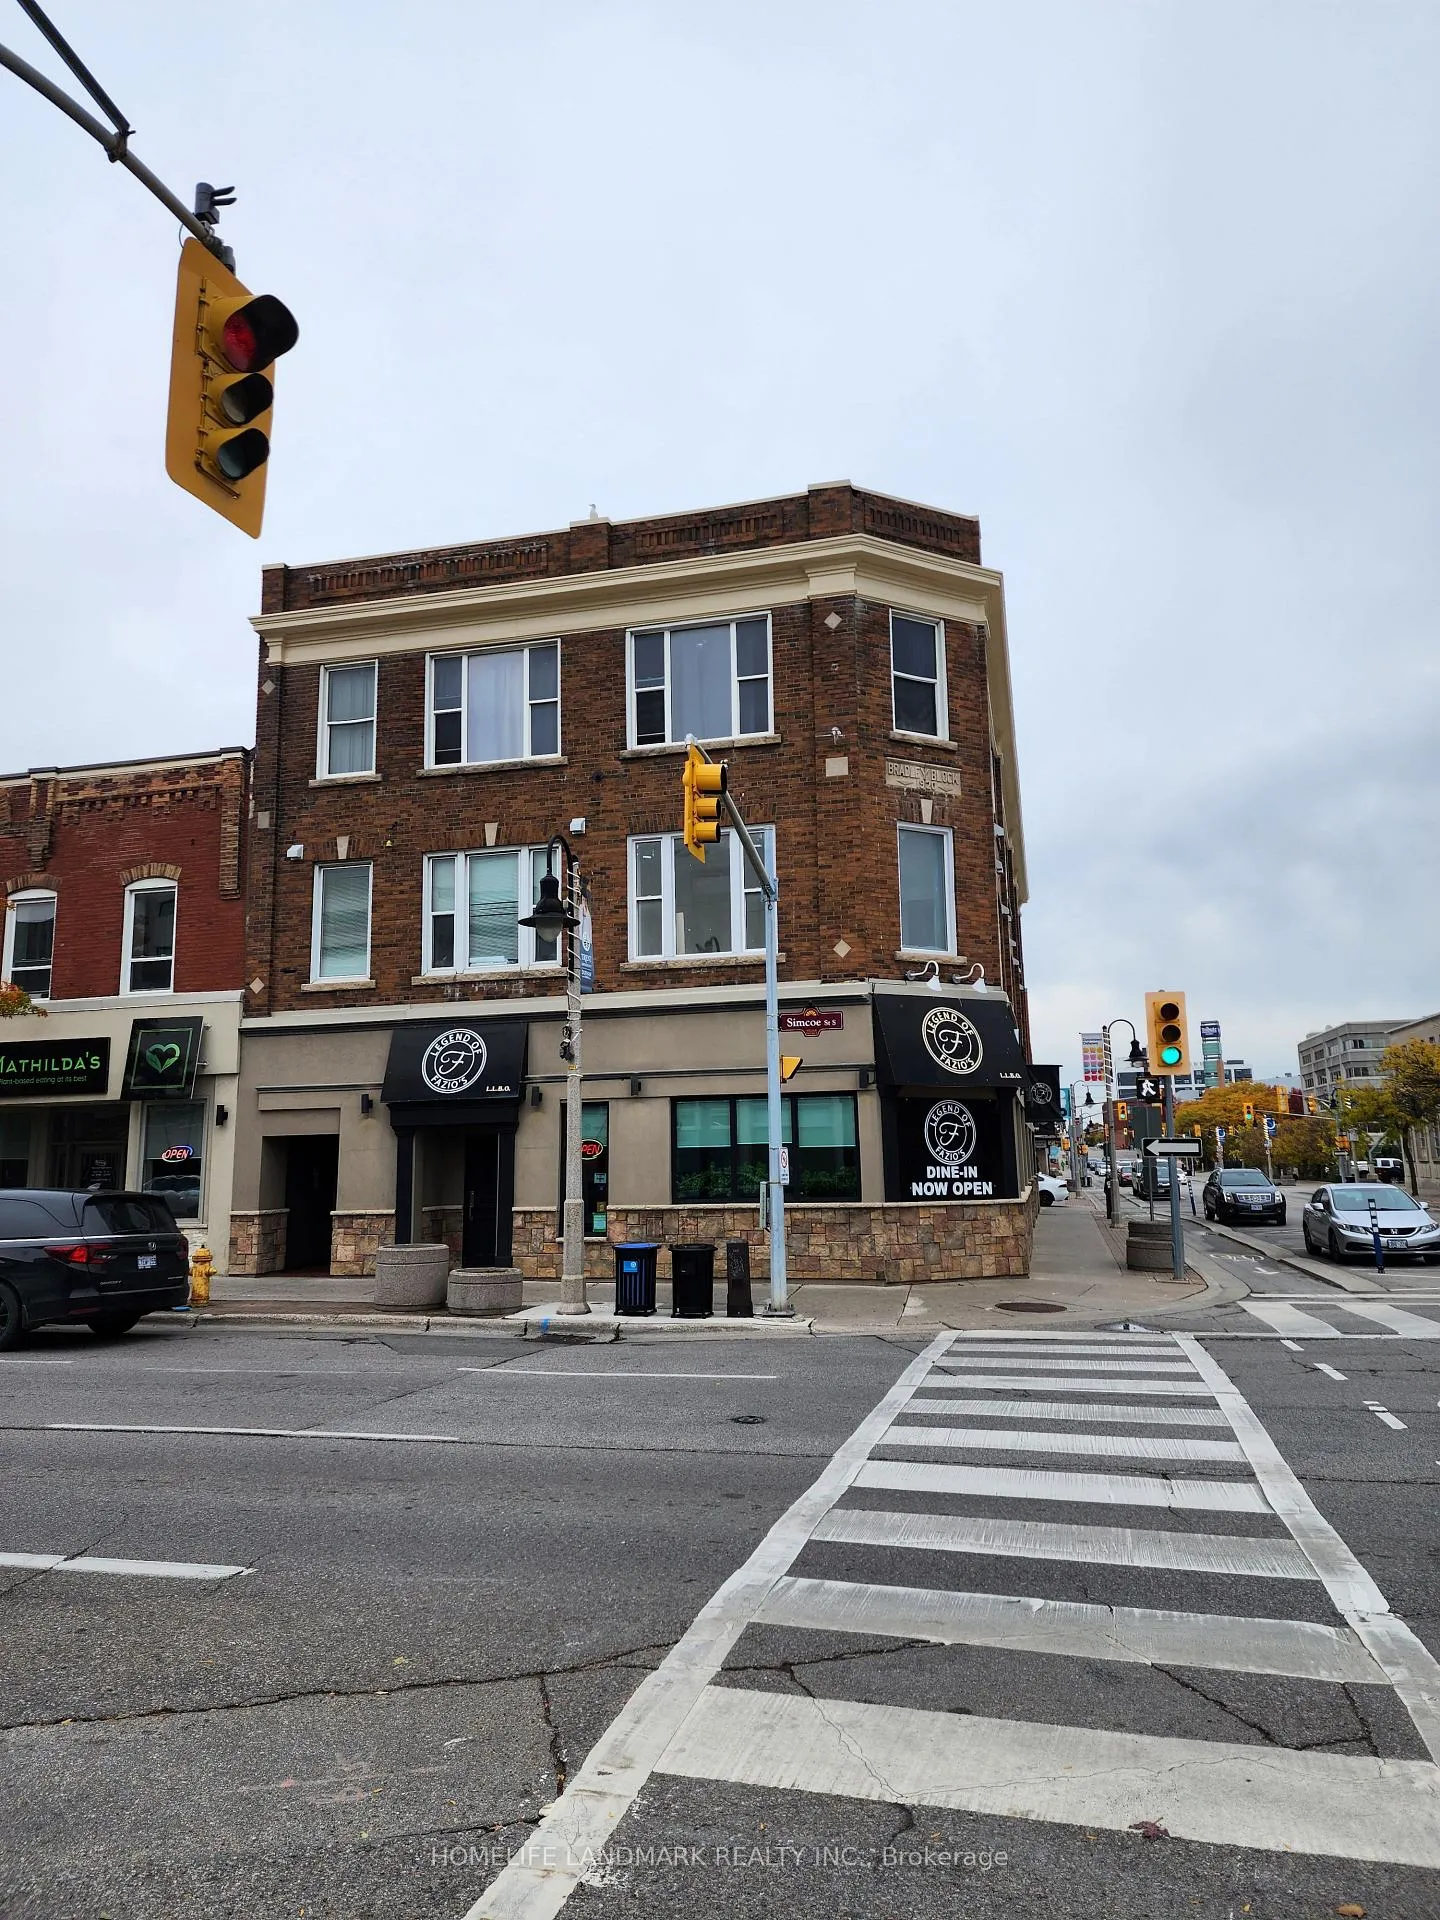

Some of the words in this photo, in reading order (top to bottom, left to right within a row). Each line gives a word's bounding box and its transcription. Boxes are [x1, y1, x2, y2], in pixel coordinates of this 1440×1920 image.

[889, 763, 929, 781] BRADLEY
[932, 769, 959, 785] BLOCK
[916, 780, 936, 790] 1920
[786, 1017, 821, 1027] Simcoe
[927, 1012, 957, 1034] LEGEND
[961, 1021, 974, 1036] OF
[430, 1033, 470, 1056] LEGEND
[471, 1041, 482, 1055] OF
[940, 1054, 975, 1070] FAZIO'S
[430, 1074, 468, 1089] FAZIO'S
[929, 1104, 960, 1127] LEGEND
[961, 1114, 972, 1128] OF
[164, 1148, 189, 1160] OPEN
[581, 1144, 600, 1155] PEN
[935, 1146, 966, 1161] FAZIO'S
[926, 1166, 978, 1179] DINE-IN
[911, 1181, 948, 1196] NOW
[952, 1181, 993, 1195] OPEN
